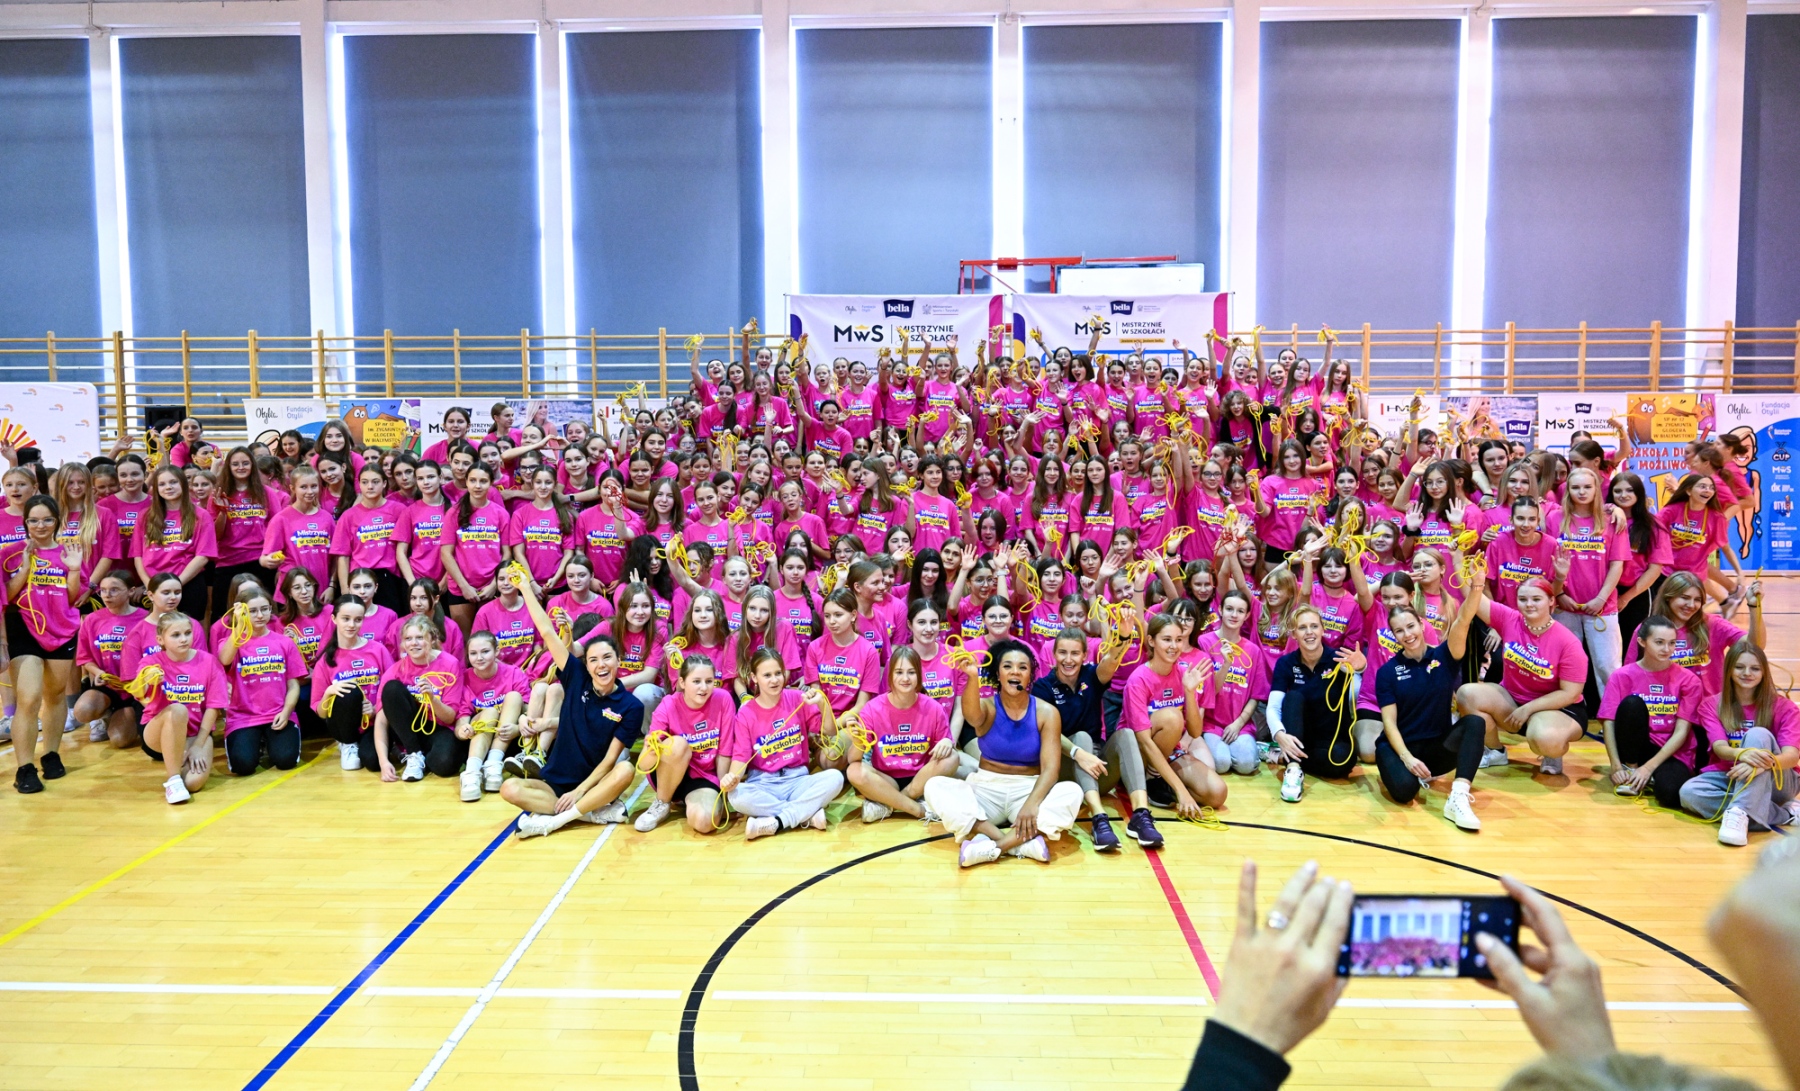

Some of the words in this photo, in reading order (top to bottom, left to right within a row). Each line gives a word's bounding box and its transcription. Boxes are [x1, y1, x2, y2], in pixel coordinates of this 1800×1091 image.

[888, 304, 910, 313] bella
[834, 325, 883, 343] MwS
[286, 406, 313, 414] Fundacja
[1546, 419, 1574, 429] MwS
[1630, 448, 1669, 457] SZKOŁA
[1638, 459, 1690, 470] MOŻLIWO
[1506, 563, 1542, 573] Mistrzynie
[501, 628, 533, 637] Mistrzynie
[1512, 642, 1549, 666] Mistrzynie
[243, 655, 282, 664] Mistrzynie
[253, 664, 282, 673] szkołach
[820, 665, 856, 674] Mistrzynie
[1514, 656, 1546, 676] szkołach
[339, 668, 378, 679] Mistrzynie
[828, 676, 854, 685] szkołach
[1649, 705, 1677, 713] zkołach
[885, 733, 925, 743] Mistrzynie
[893, 745, 925, 753] szkołach
